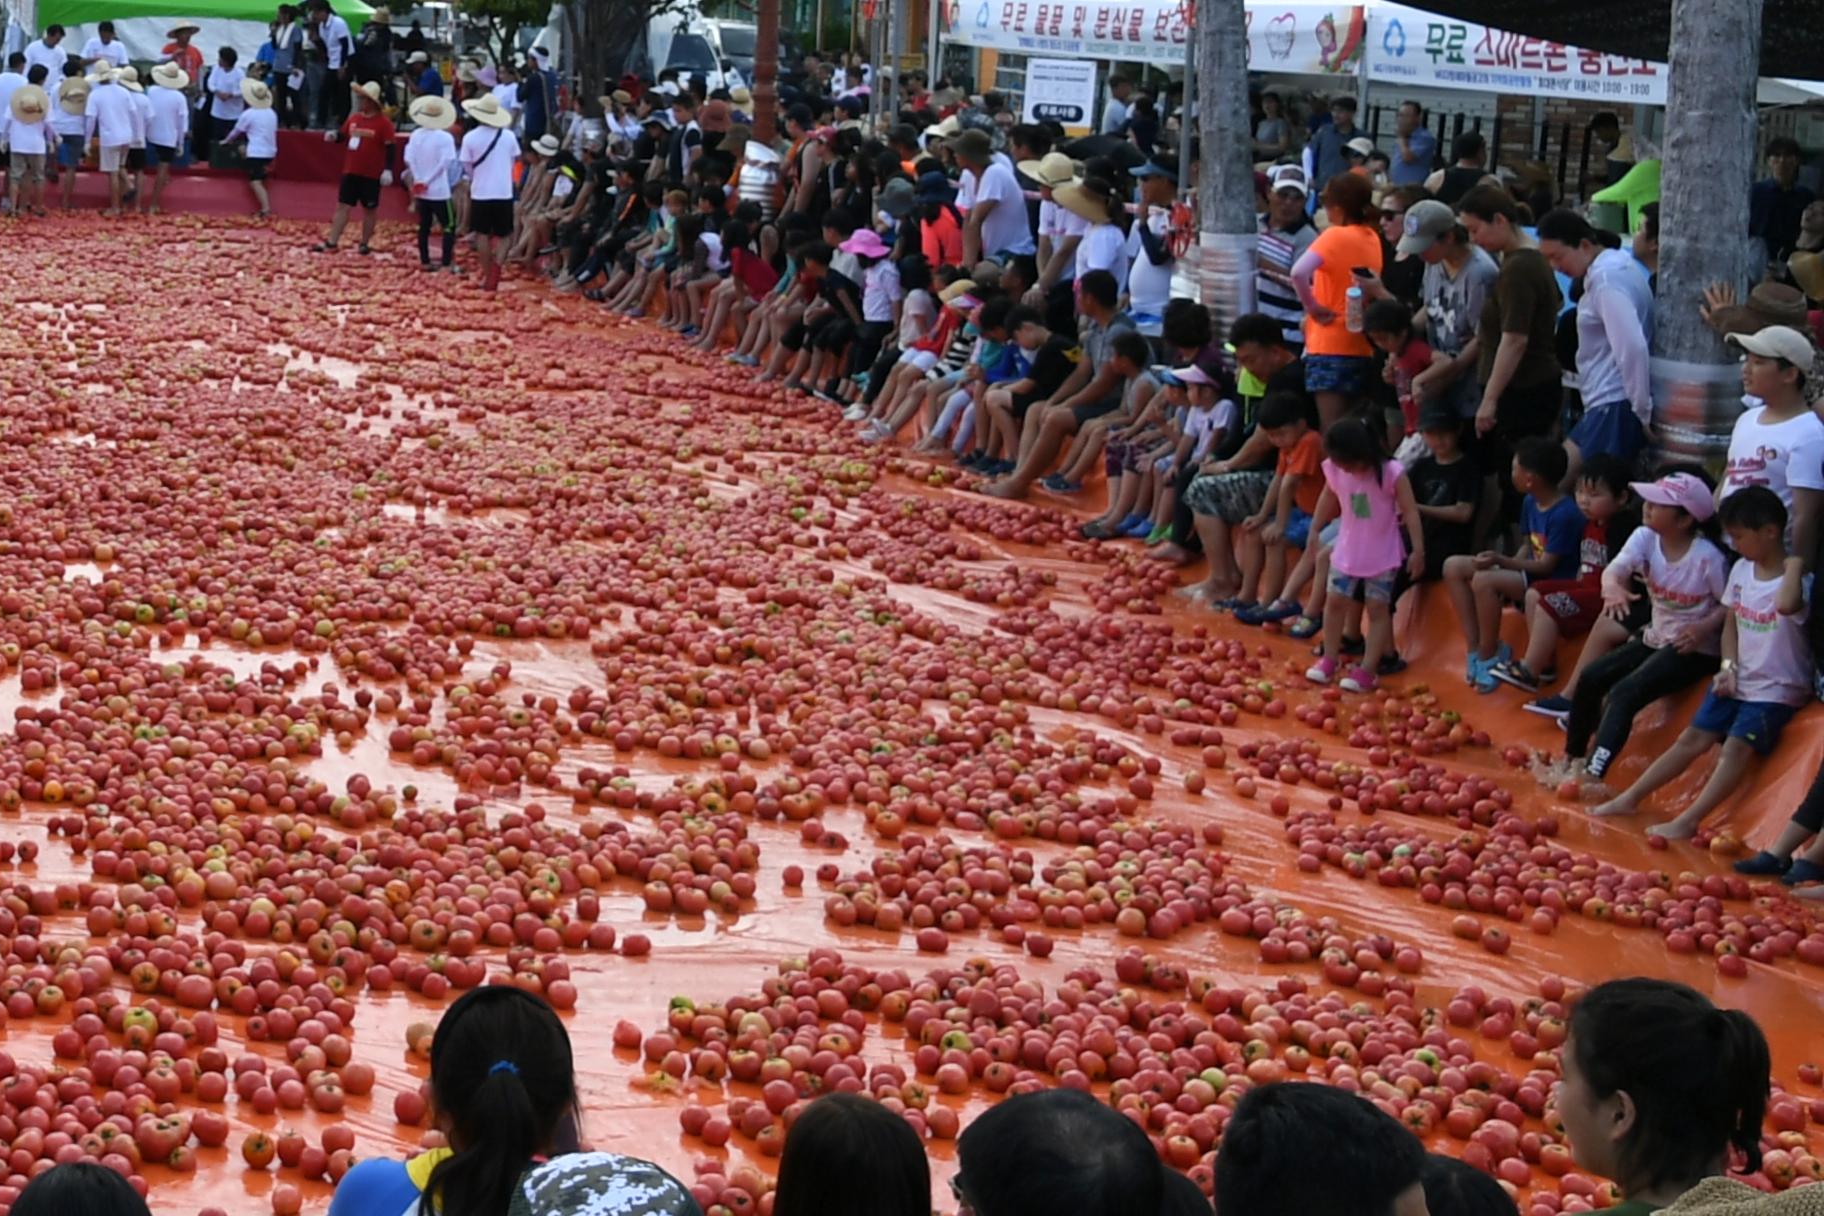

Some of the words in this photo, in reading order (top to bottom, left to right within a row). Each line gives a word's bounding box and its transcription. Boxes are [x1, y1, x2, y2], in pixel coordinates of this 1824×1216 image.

[1000, 2, 1027, 33] 무료
[1035, 4, 1064, 37] 물품
[1072, 5, 1087, 39] 및
[1094, 7, 1145, 42] 분실물
[1425, 23, 1467, 64] 무료
